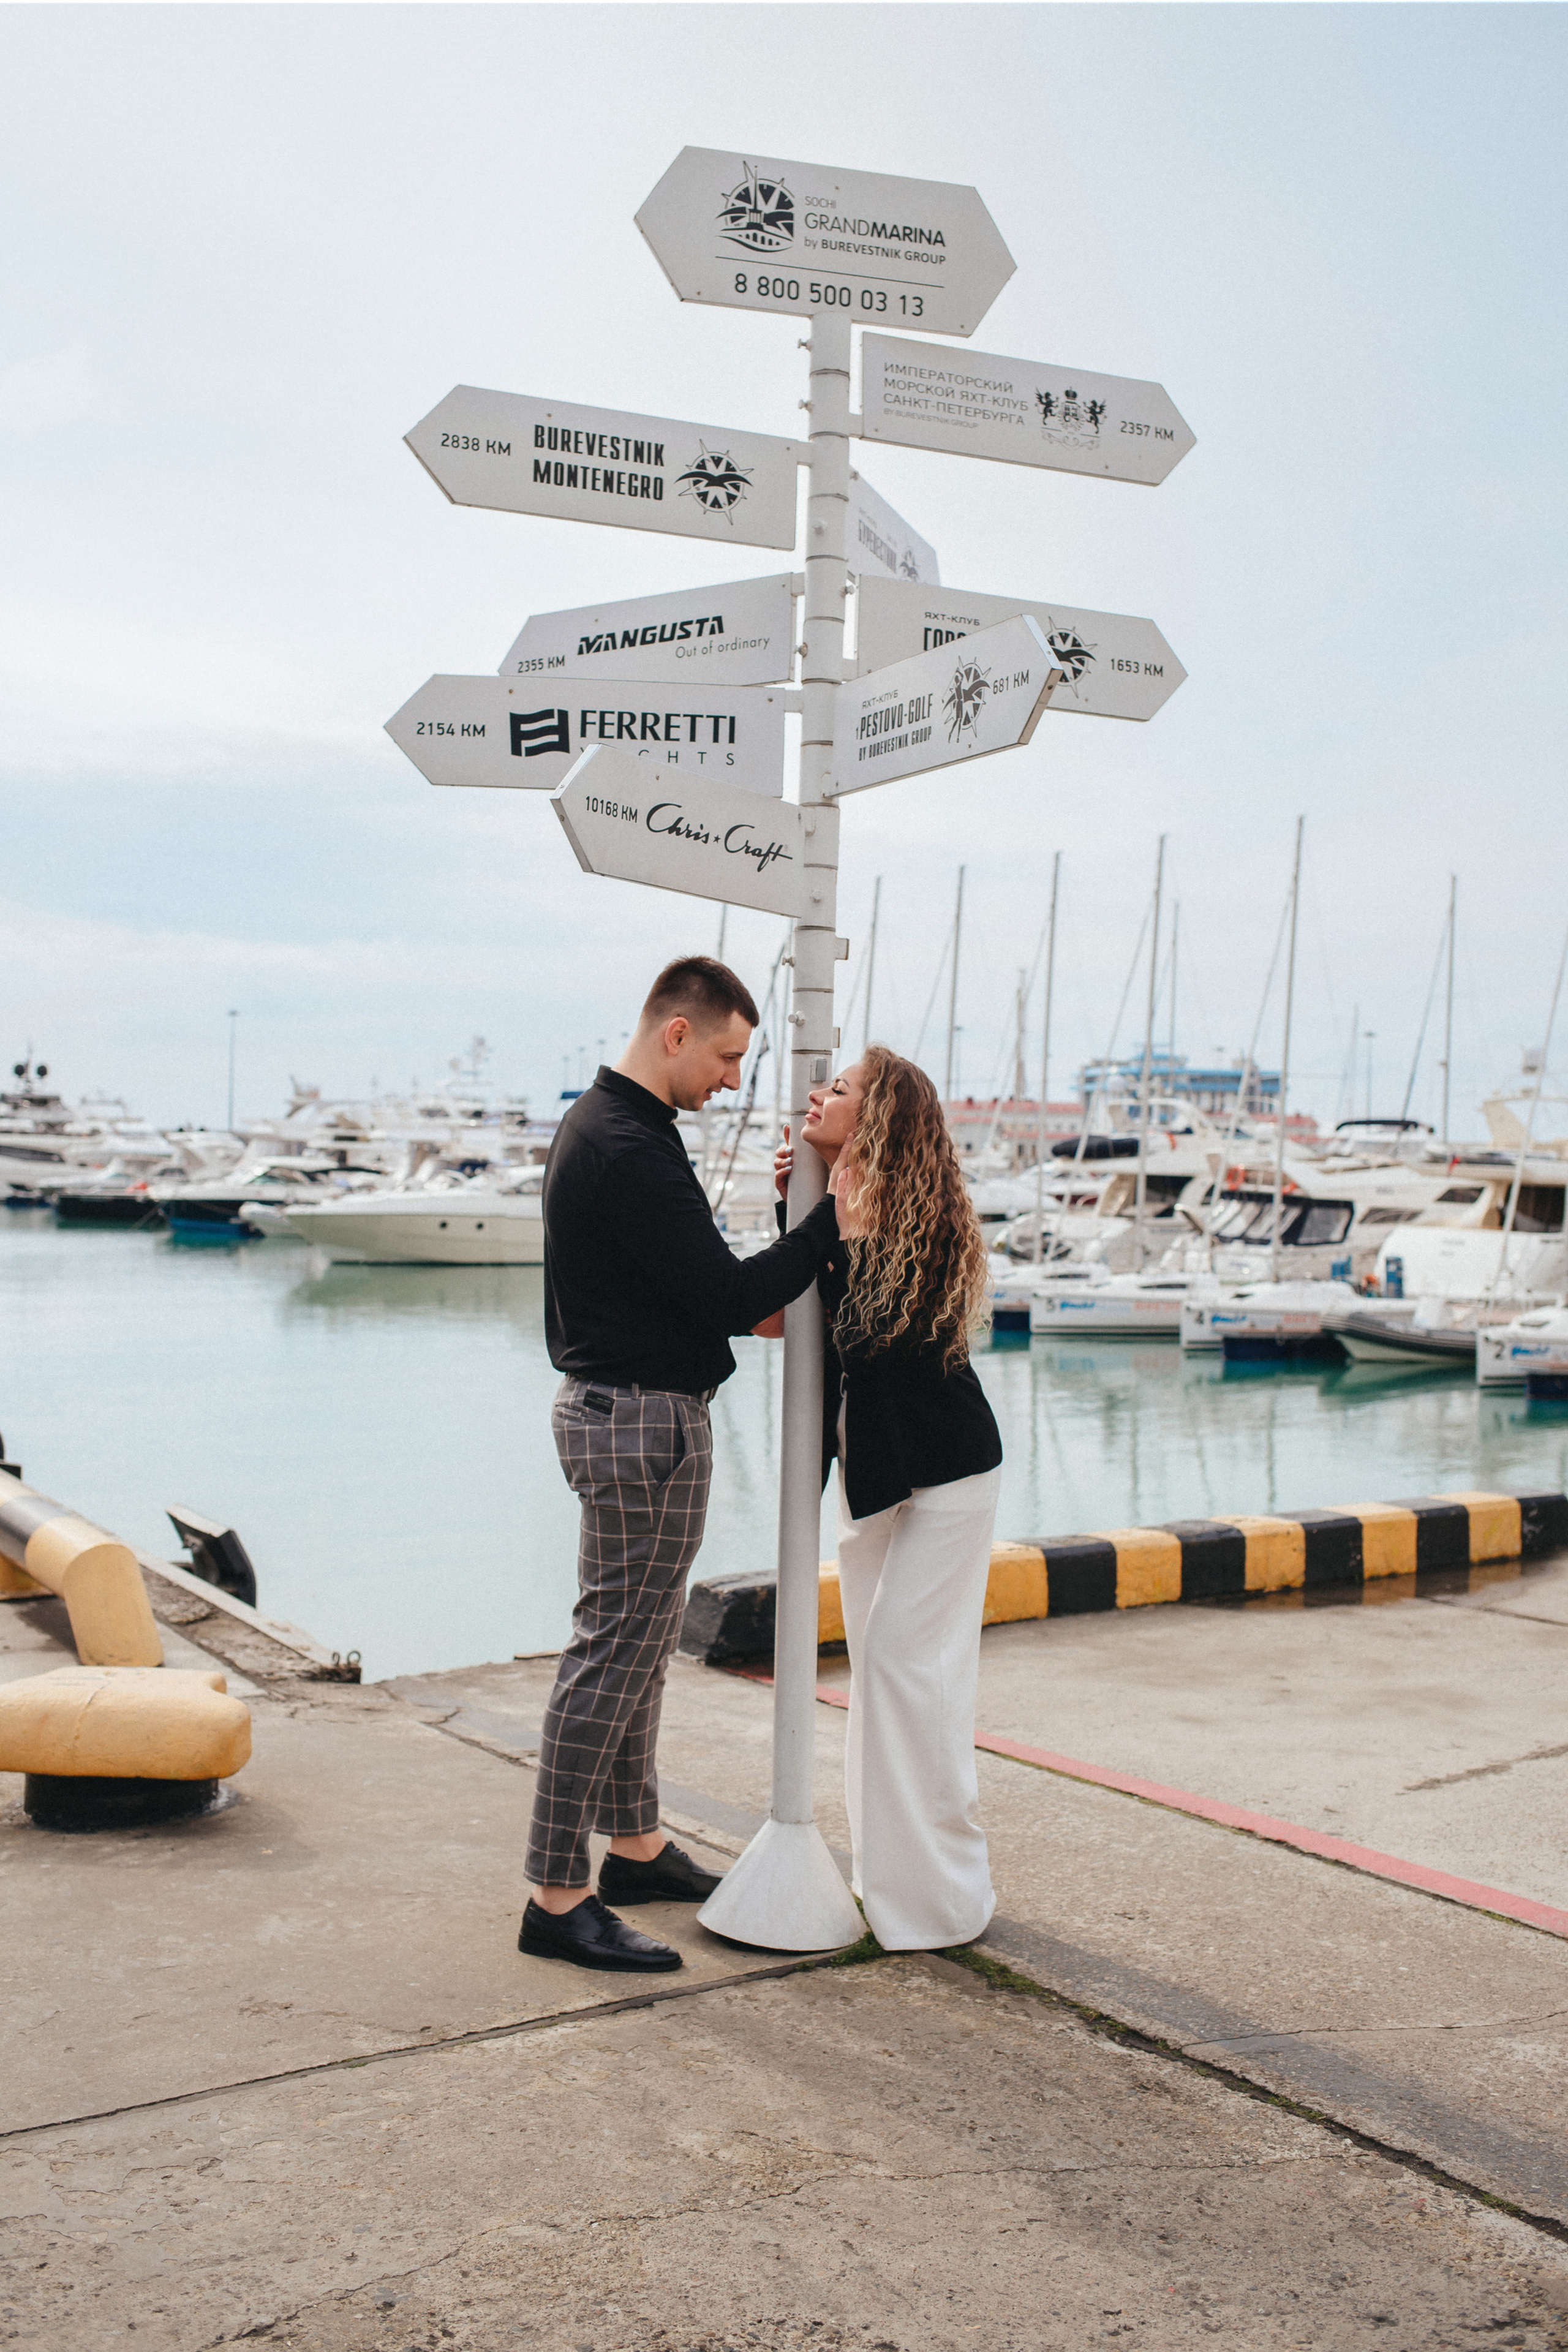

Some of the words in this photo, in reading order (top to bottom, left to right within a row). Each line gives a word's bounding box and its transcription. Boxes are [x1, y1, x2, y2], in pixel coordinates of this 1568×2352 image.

[805, 196, 836, 209] SOCHI
[804, 213, 946, 247] GRANDMARINA
[804, 236, 818, 249] by
[821, 239, 901, 259] BUREVESTNIK
[904, 251, 946, 265] GROUP
[734, 273, 747, 293] 8
[757, 276, 800, 300] 800
[810, 282, 851, 307] 500
[861, 290, 887, 312] 03
[900, 295, 924, 317] 13
[884, 363, 1013, 393] ИМПЕРАТОРСКИЙ
[884, 377, 955, 398] МОРСКОЙ
[960, 391, 1028, 411] ЯХТ-КЛУБ
[883, 393, 1025, 425] САНКТ-ПЕТЕРБУРГА
[1120, 421, 1150, 436] 2357
[441, 433, 480, 451] 2838
[486, 439, 511, 456] KM
[534, 424, 665, 467] BUREVESTNIK
[533, 459, 663, 500] MONTENEGRO
[924, 611, 980, 626] ЯХТ-КЛУБ
[578, 616, 724, 655] MANGUSTA
[676, 646, 696, 658] Out
[701, 640, 713, 655] of
[717, 638, 770, 652] ordinary
[518, 658, 544, 673] 2355
[548, 655, 565, 668] KM
[1111, 658, 1139, 674] 1653
[862, 689, 898, 709] ЯХТ-КЛУБ
[993, 676, 1009, 695] 681
[417, 722, 455, 736] 2154
[461, 723, 486, 737] KM
[580, 710, 736, 744] FERRETTI
[859, 747, 867, 761] BY
[869, 733, 908, 758] BUREVESTNIK
[911, 726, 932, 745] GROUP
[586, 796, 618, 818] 10168
[621, 805, 638, 823] KM
[646, 803, 710, 844] Chris
[724, 824, 793, 872] Craft
